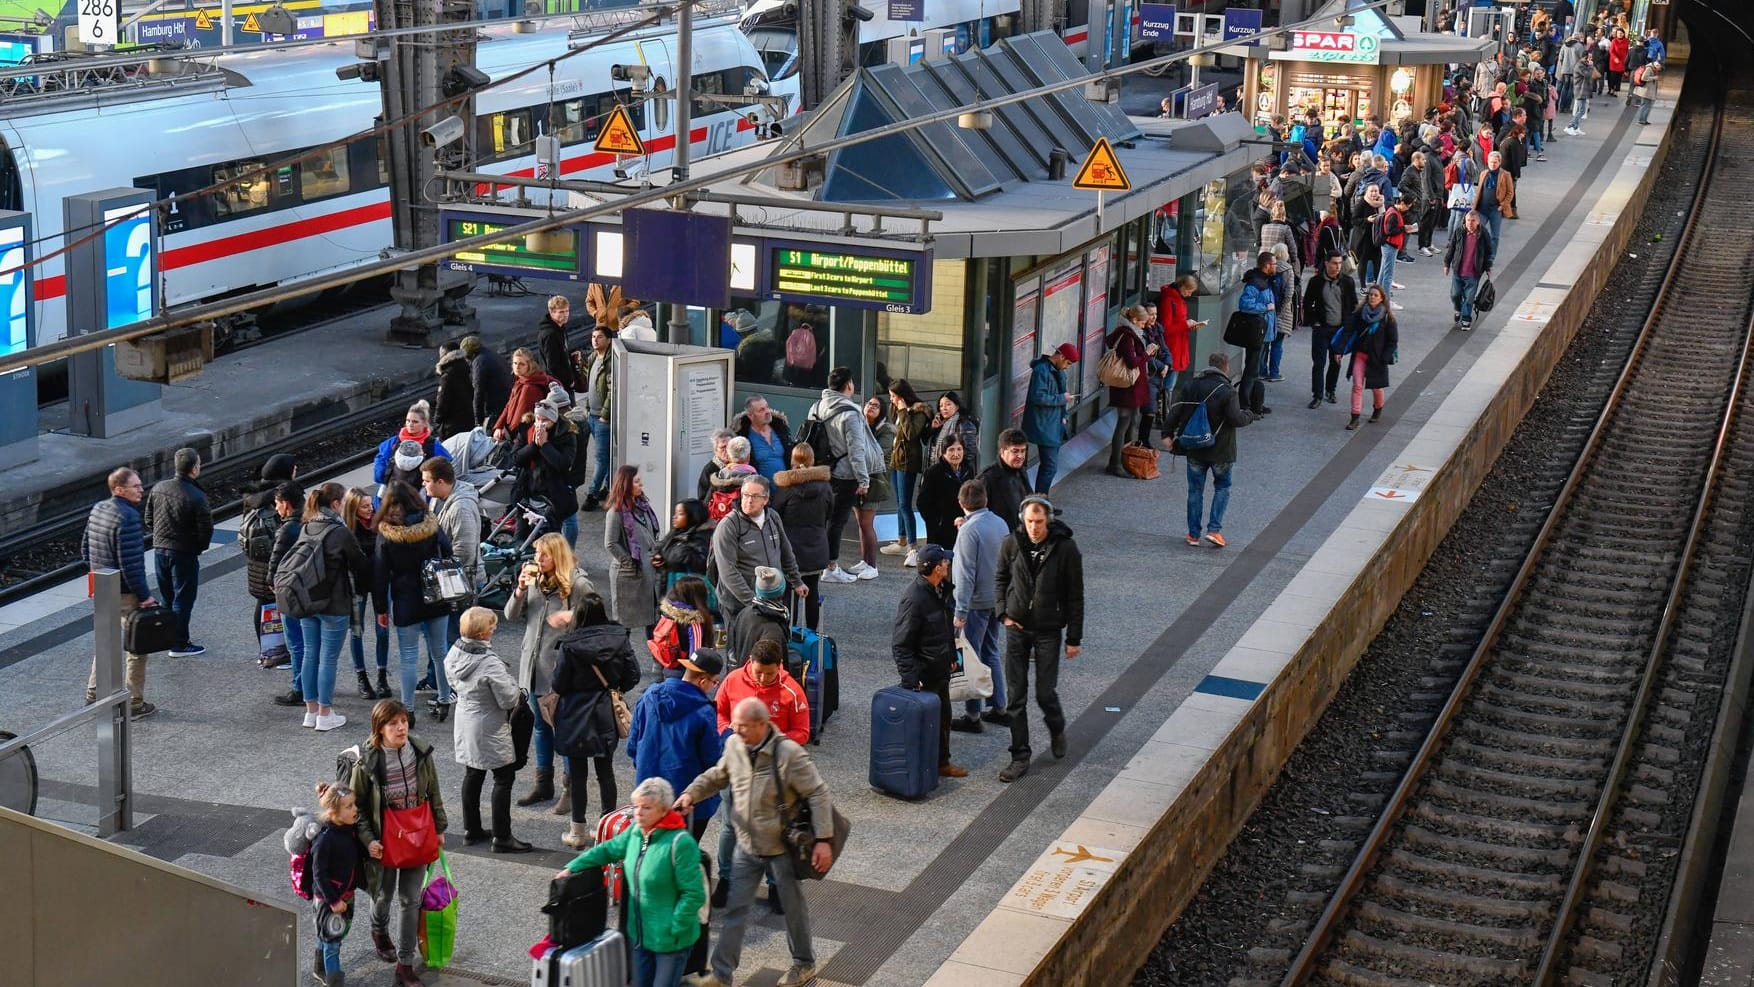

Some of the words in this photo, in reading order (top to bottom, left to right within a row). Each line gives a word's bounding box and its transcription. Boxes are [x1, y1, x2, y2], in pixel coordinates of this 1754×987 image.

[82, 0, 113, 16] 286
[92, 19, 104, 38] 6
[142, 23, 172, 38] Hamburg
[173, 22, 185, 34] Hbf
[1143, 20, 1169, 30] Kurzzug
[1228, 25, 1255, 34] Kurzzug
[1142, 30, 1159, 38] Ende
[1294, 33, 1353, 49] SPAR
[1305, 51, 1377, 62] express
[706, 119, 735, 156] ICE
[462, 222, 477, 235] S21
[450, 262, 467, 271] Gleis
[789, 251, 801, 264] S1
[811, 253, 908, 274] Airport/Poppenbüttel
[811, 272, 825, 280] First
[830, 274, 843, 282] cars
[851, 275, 873, 284] Airport
[811, 284, 823, 292] Last
[849, 287, 888, 298] Poppenbüttel
[886, 304, 905, 313] Gleis
